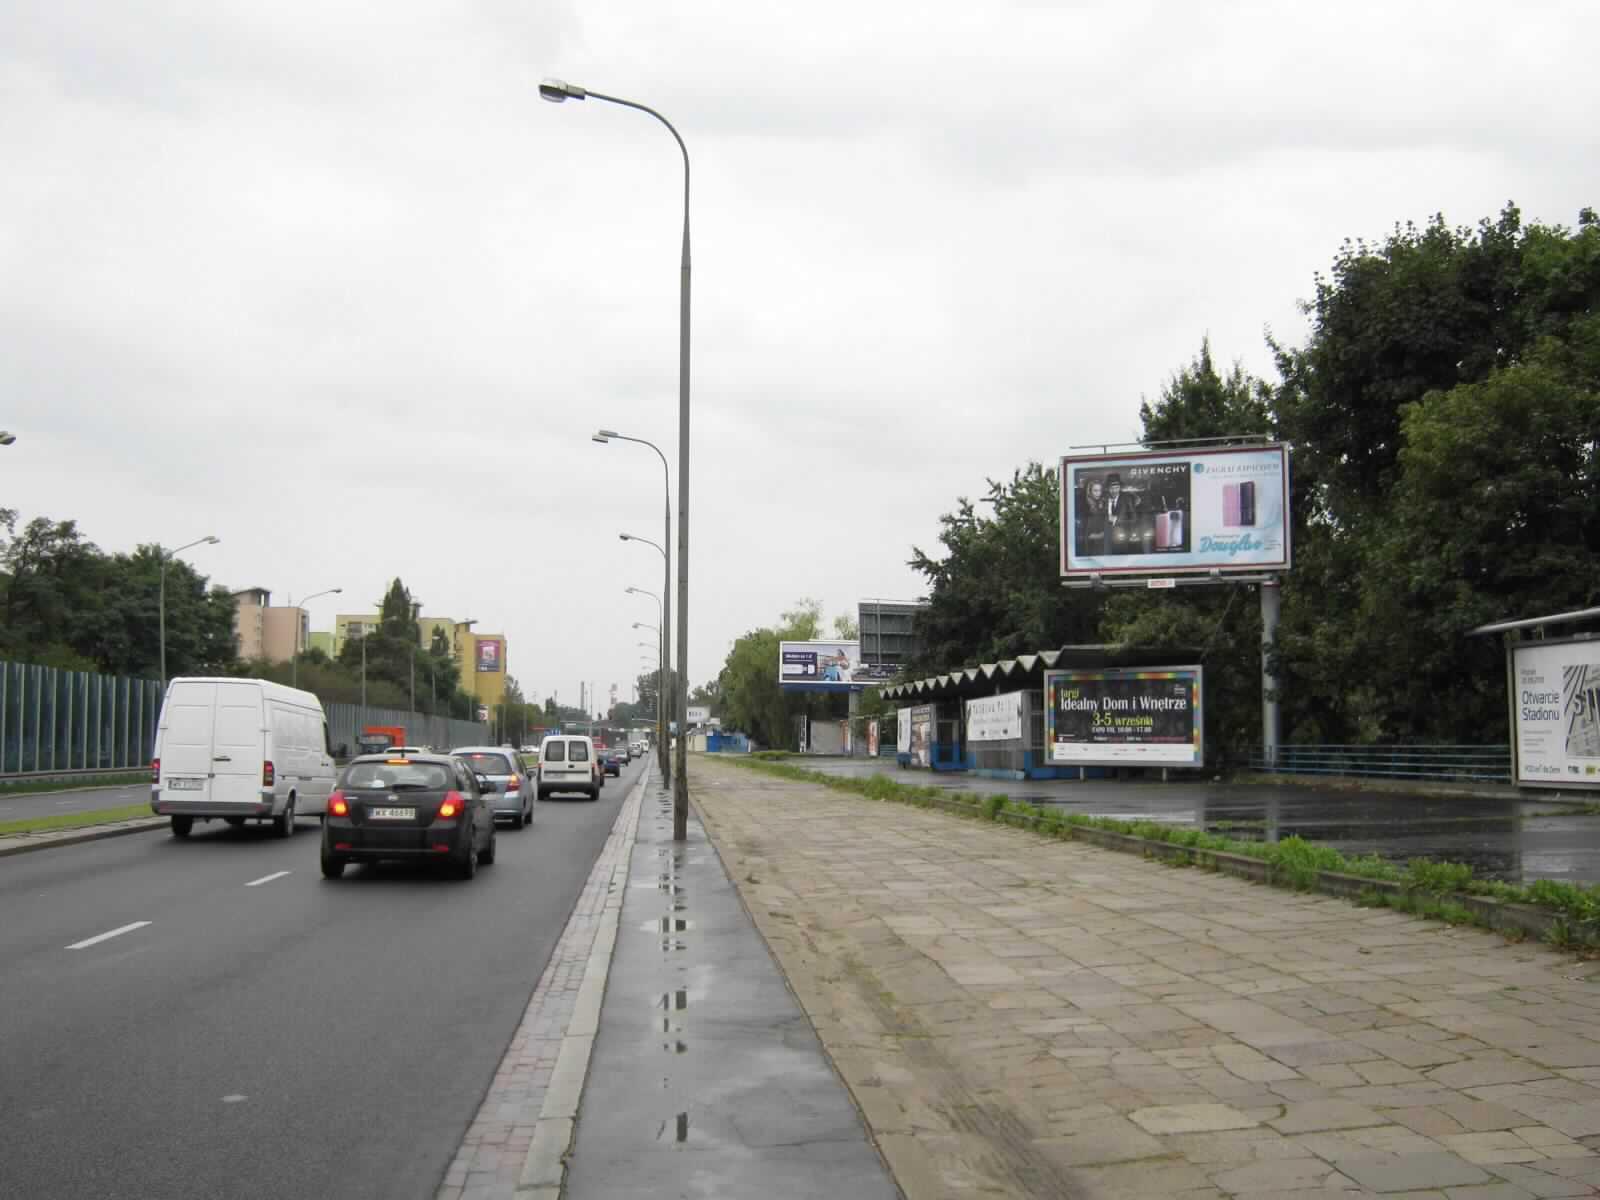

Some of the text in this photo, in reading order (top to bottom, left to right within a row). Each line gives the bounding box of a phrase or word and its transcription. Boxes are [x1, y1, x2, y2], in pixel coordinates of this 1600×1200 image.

[1130, 465, 1186, 475] GIVENCHY
[1061, 697, 1098, 712] Idealny
[1103, 697, 1129, 710] Dom
[1140, 696, 1187, 712] Wnętrze
[1522, 690, 1559, 704] Otwarcie
[1092, 712, 1112, 726] 3-5
[1522, 707, 1559, 721] Stadionu
